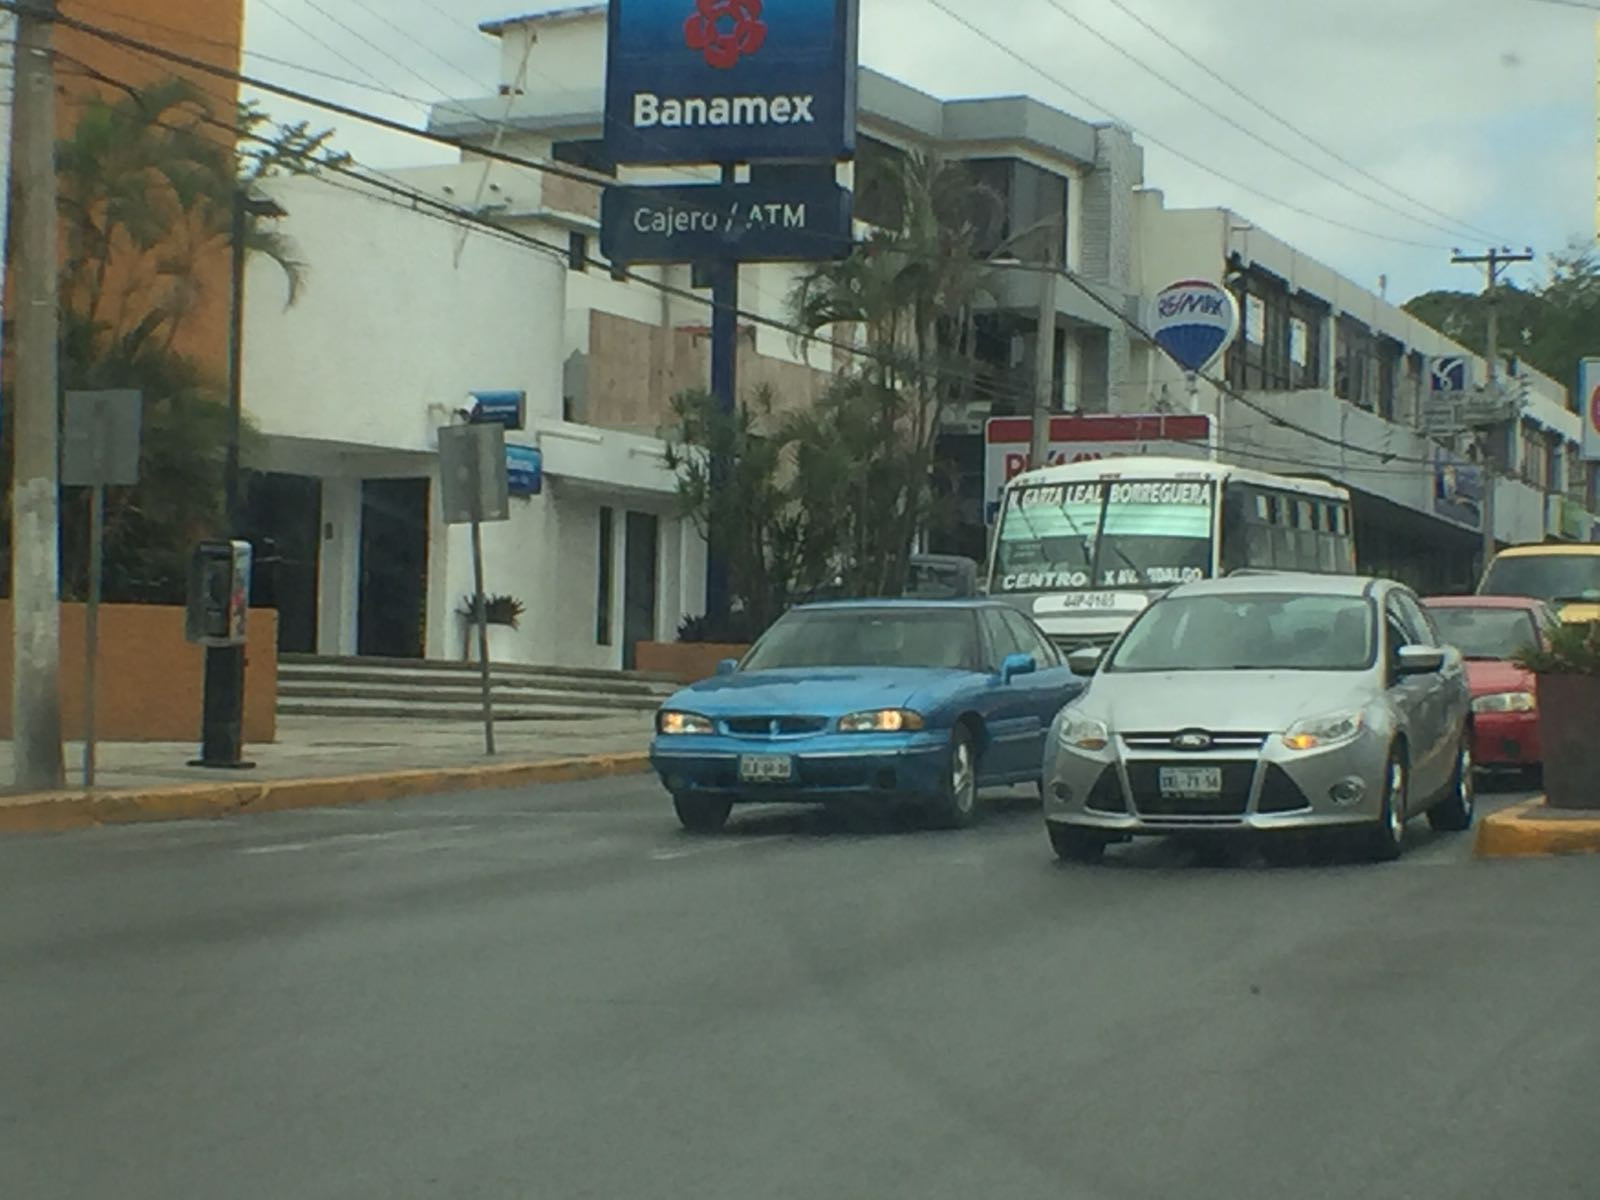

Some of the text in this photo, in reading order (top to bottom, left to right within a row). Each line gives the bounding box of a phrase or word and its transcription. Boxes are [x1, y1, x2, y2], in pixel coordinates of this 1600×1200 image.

[634, 93, 814, 128] Banamex
[633, 206, 718, 238] Cajero
[745, 203, 806, 230] ATM
[1065, 482, 1104, 504] LEAL
[1002, 571, 1088, 590] CENTRO
